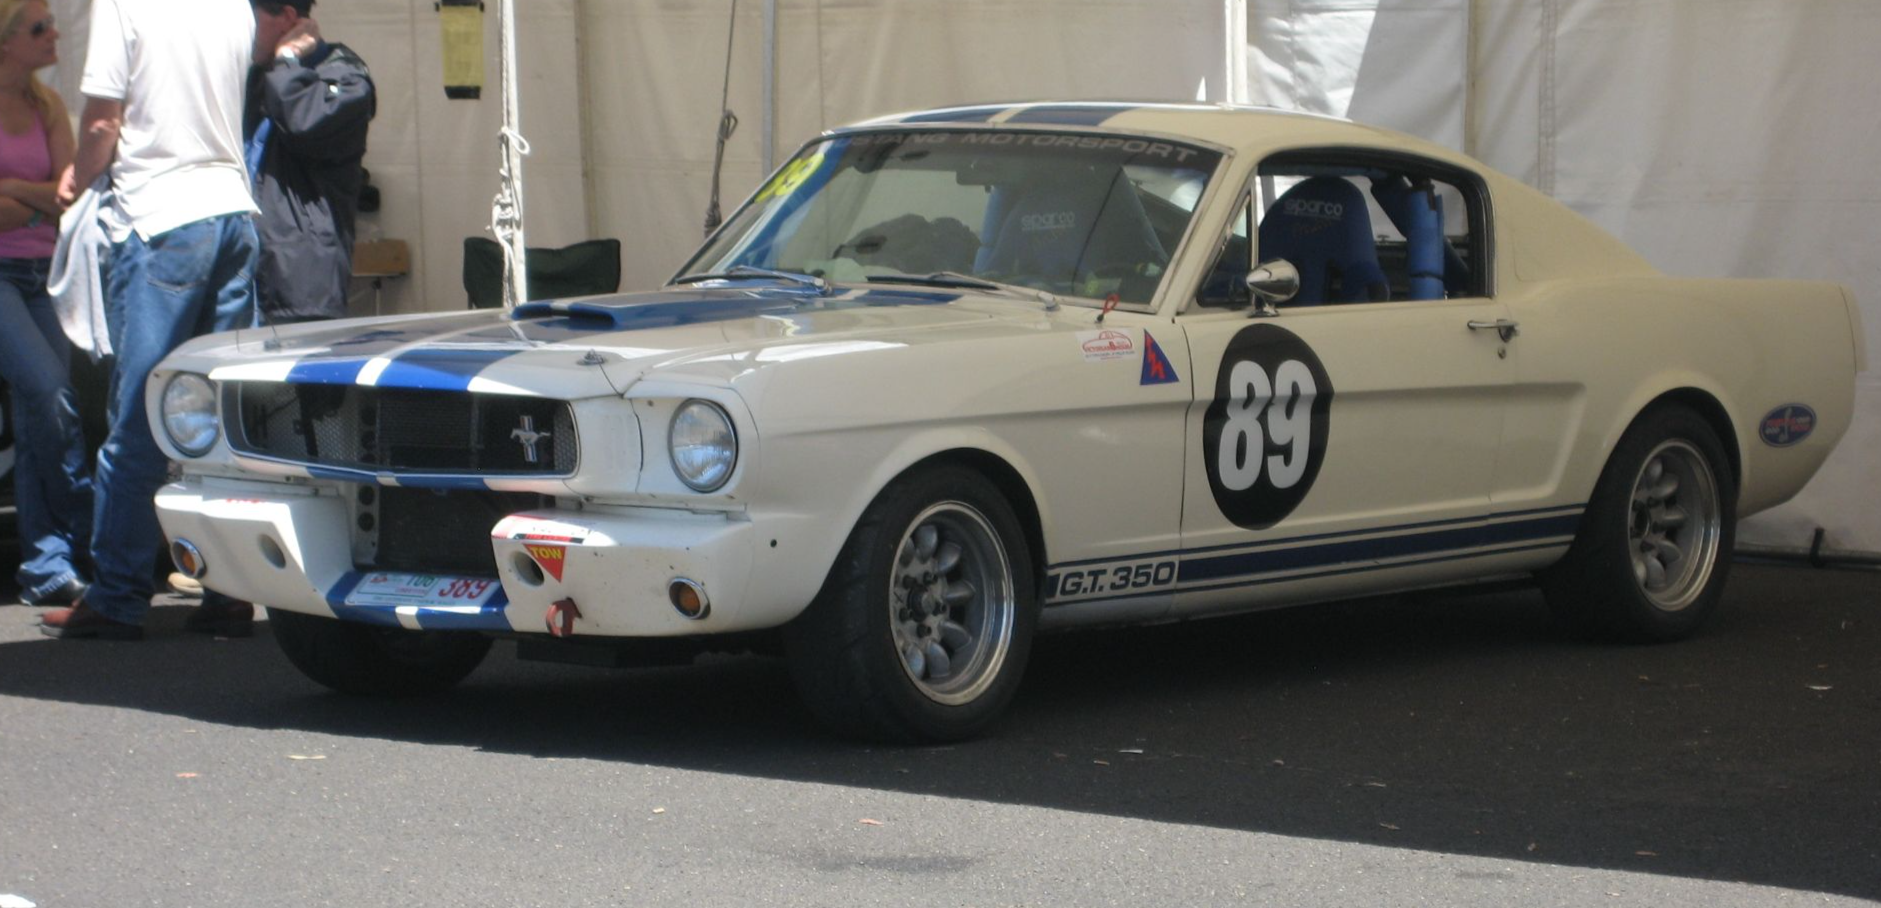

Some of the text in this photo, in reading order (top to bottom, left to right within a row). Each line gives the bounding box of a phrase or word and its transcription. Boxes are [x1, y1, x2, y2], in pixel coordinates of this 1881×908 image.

[961, 133, 1199, 163] MOTORSPORT
[1021, 210, 1076, 231] sparco
[1283, 199, 1343, 220] sparco
[1218, 359, 1317, 491] 89
[530, 546, 563, 560] TOW
[438, 577, 494, 600] 389
[1060, 561, 1176, 596] G.T. 350
